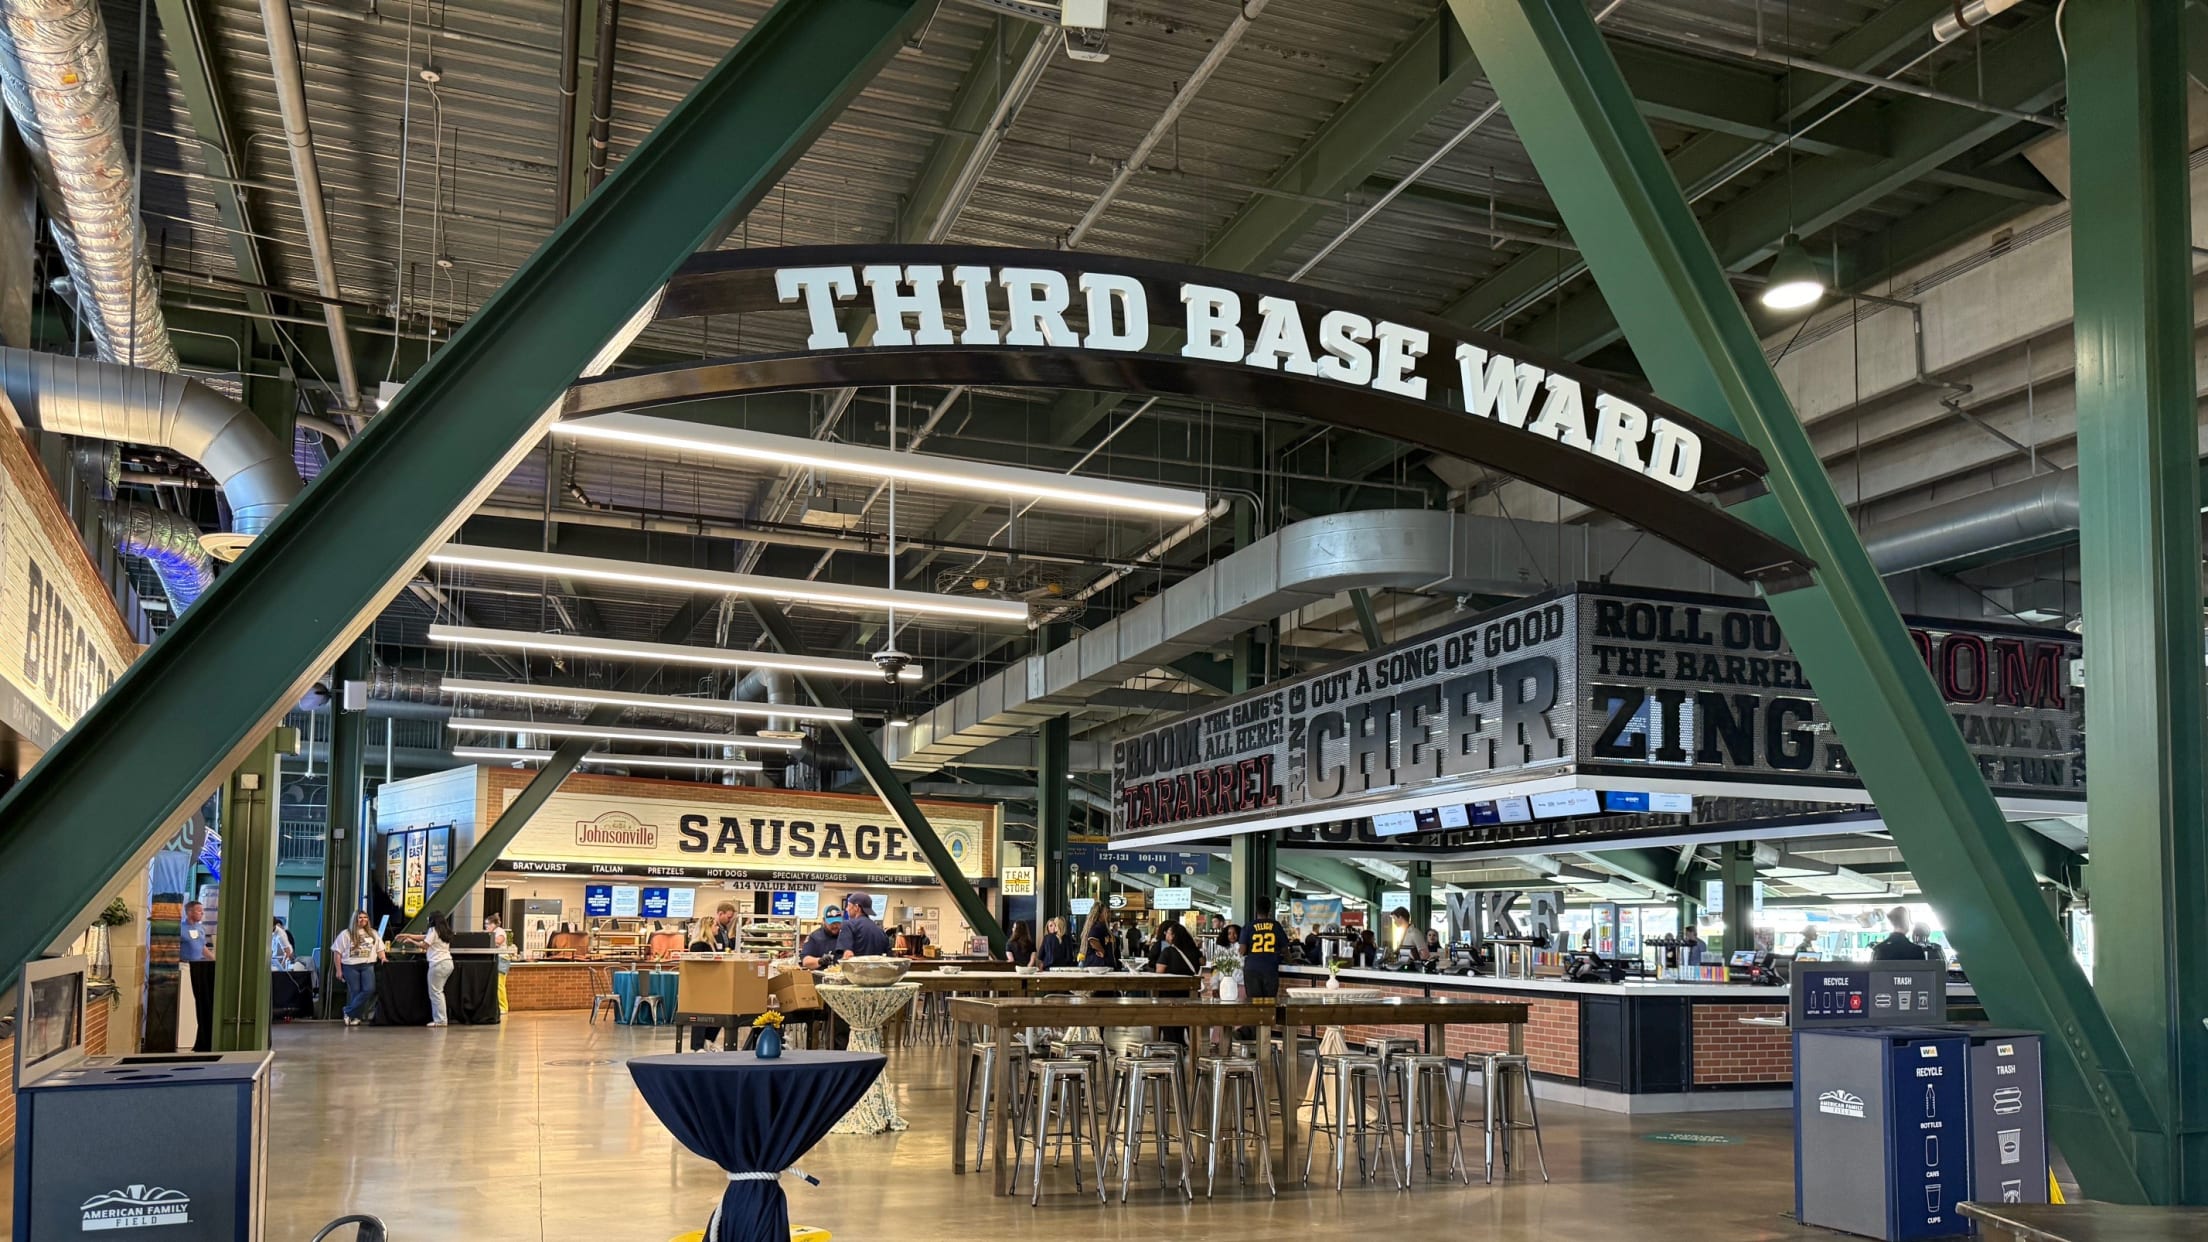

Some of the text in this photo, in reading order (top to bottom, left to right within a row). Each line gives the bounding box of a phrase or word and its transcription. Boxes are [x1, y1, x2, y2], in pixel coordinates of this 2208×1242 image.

[774, 265, 1703, 493] THIRD BASE WARD
[1594, 599, 1794, 652] ROLL OU
[1312, 603, 1564, 708] OUT A SONG OF GOOD
[1591, 644, 1666, 678] THE
[1204, 691, 1284, 735] THE GANG'S
[1307, 655, 1565, 800] CHEER
[1591, 683, 1815, 770] ZING
[1204, 717, 1284, 762] ALL HERE!
[2037, 719, 2063, 751] A
[1124, 717, 1202, 781] BOOM
[1123, 753, 1283, 830] TARARREL
[579, 824, 654, 846] Johnsonville
[408, 845, 424, 859] EASY
[1098, 853, 1130, 861] 127-131
[512, 861, 568, 872] BRATWURST
[592, 864, 624, 874] ITALIAN
[647, 866, 685, 876] PRETZELS
[706, 869, 748, 879] HOT DOGS
[772, 871, 848, 882] SPECIALTY SAUSAGES
[867, 874, 912, 884] FRENCH FRIES
[732, 881, 817, 892] 414 VALUE MENU
[1005, 871, 1031, 893] TEAM STORE
[1251, 933, 1276, 953] 22
[1823, 977, 1849, 986] RECYCLE
[1893, 976, 1912, 986] TRASH
[1916, 1067, 1943, 1078] RECYCLE
[1996, 1065, 2016, 1075] TRASH
[1920, 1121, 1943, 1129] BOTTLES
[83, 1203, 188, 1220] AMERICAN FAMILY
[115, 1216, 158, 1227] FIELD
[1927, 1216, 1941, 1224] CUPS
